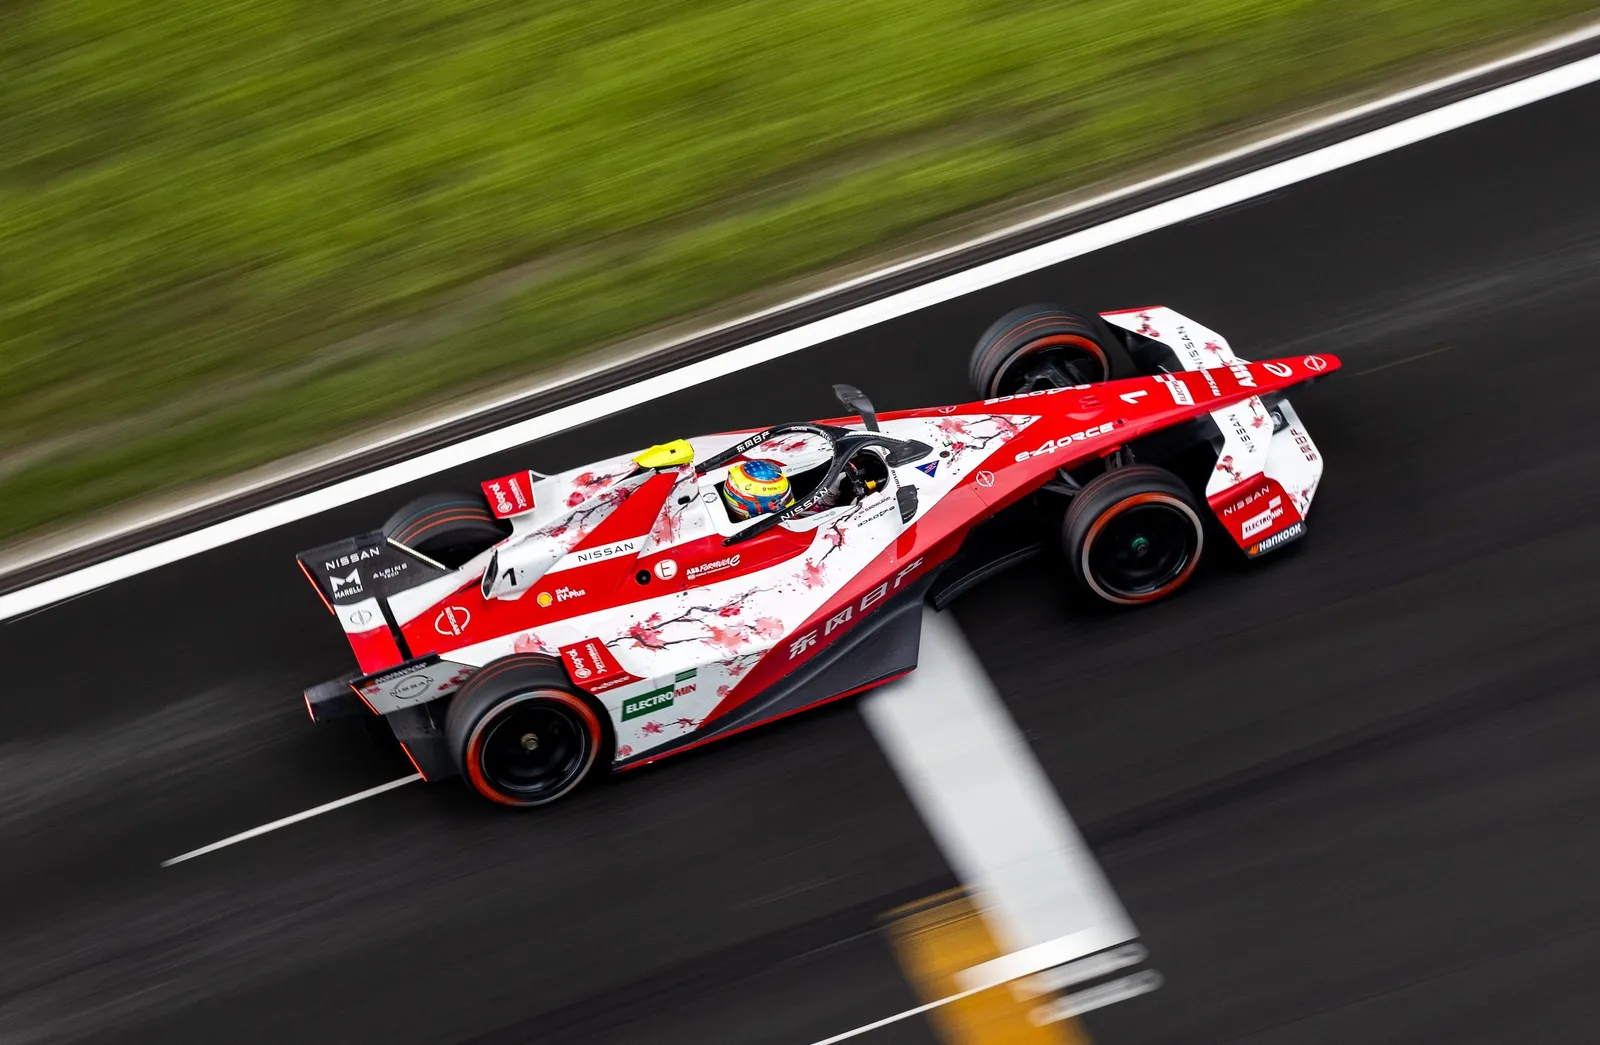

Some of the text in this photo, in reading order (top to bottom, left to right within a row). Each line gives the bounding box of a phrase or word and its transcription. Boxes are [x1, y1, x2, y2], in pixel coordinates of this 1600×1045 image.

[1176, 325, 1204, 371] NISSAN
[736, 430, 770, 453] 东风日产
[1227, 413, 1257, 454] NISSAN
[780, 486, 829, 522] NISSAN
[1223, 485, 1270, 517] NISSAN
[325, 546, 380, 571] NISSAN
[577, 542, 634, 563] NISSAN
[334, 585, 364, 600] MARELLI
[502, 566, 518, 587] 1
[788, 556, 924, 661] 东风日产
[625, 683, 697, 715] ELECTROMIN
